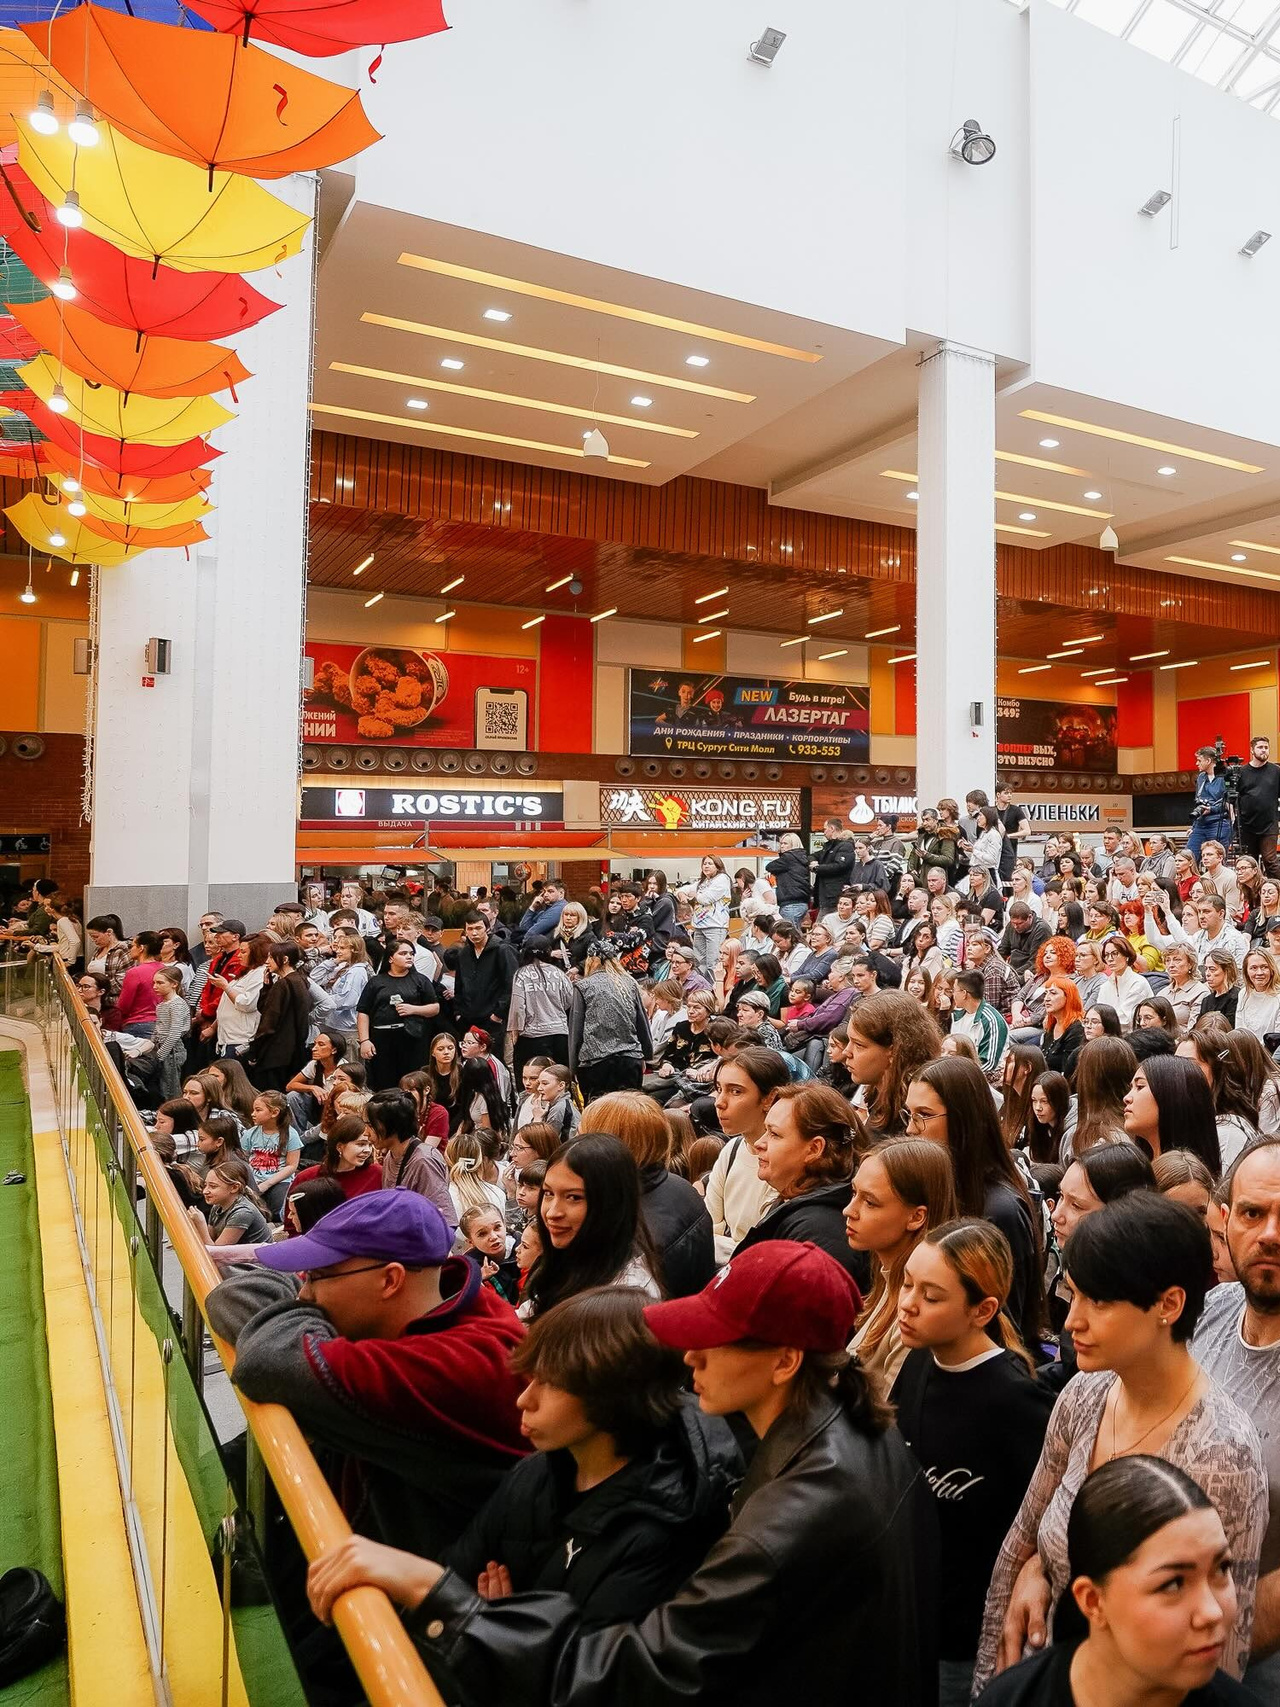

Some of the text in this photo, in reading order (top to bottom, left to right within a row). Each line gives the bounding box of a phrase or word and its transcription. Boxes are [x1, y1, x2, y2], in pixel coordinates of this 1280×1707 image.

[516, 664, 530, 674] 12+
[741, 690, 773, 702] NEW
[789, 692, 811, 703] Будь
[820, 695, 846, 705] игре!
[998, 698, 1020, 707] Комбо
[303, 710, 336, 720] ЖЕНИЙ
[764, 707, 851, 726] ЛАЗЕРТАГ
[653, 727, 851, 744] ДНИ РОЖДЕНИЯ ПРАЗДНИКИ КОРПОРАТИВЫ
[677, 741, 775, 754] ТРЦ Сургут Сити Молл
[798, 745, 842, 756] 933-553
[998, 755, 1055, 767] ЭТО ВКУСНО
[391, 793, 543, 816] ROSTIC'S
[691, 799, 791, 817] KONG FU
[378, 820, 413, 828] ВЫДАЧА
[692, 819, 791, 829] КИТАЙСКИЙ ФД-КОРТ
